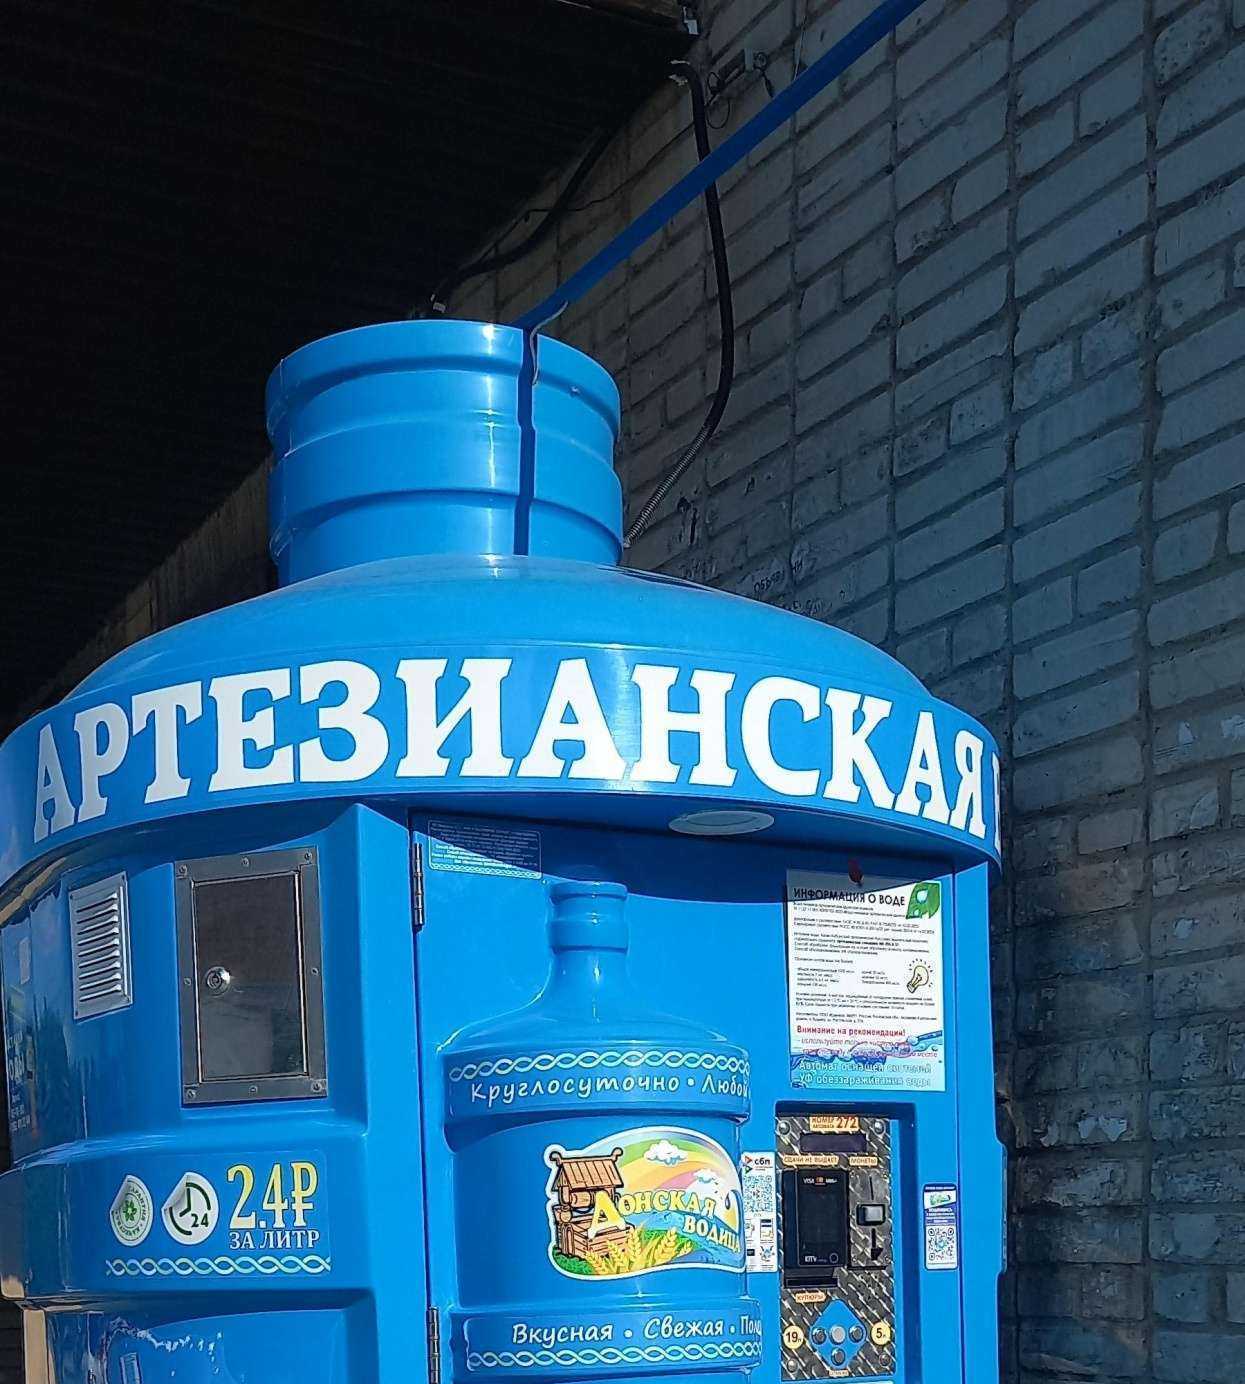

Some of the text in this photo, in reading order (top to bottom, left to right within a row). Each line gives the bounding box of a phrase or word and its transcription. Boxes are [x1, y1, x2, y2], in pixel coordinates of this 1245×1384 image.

[34, 656, 987, 843] АРТЕЗИАНСКАЯ
[794, 888, 906, 906] ИНФОРМАЦИЯ О ВОДЕ
[471, 1075, 680, 1107] Круглосуточно
[836, 1115, 858, 1129] 272
[191, 1213, 209, 1228] 24
[229, 1229, 320, 1250] ЗА ЛИТР
[512, 1323, 614, 1348] Вкусная
[643, 1314, 724, 1338] Свежая
